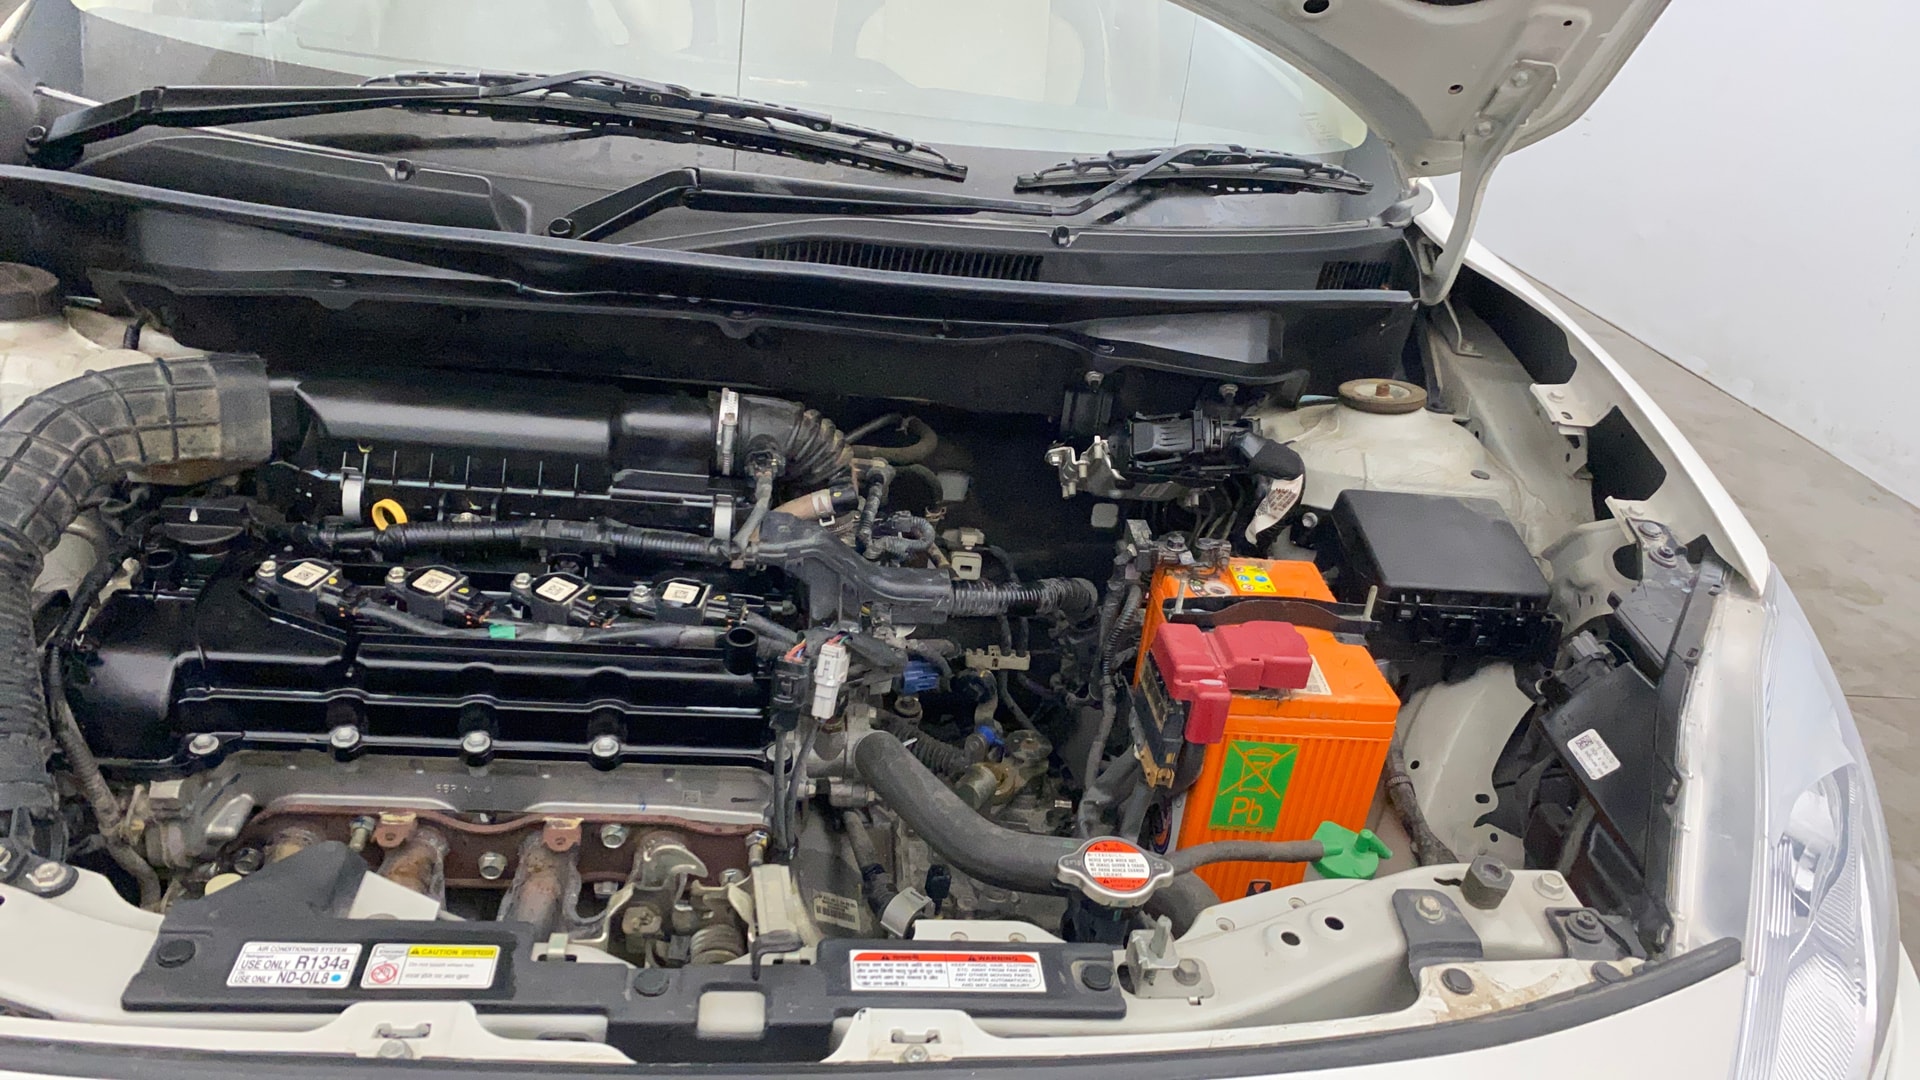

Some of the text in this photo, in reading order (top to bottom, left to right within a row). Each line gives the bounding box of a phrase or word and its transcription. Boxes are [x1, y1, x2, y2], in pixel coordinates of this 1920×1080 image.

[1228, 796, 1263, 825] Pb
[241, 955, 350, 970] USE ONLY R134a
[234, 972, 330, 984] USE ONLY ND-OIL8
